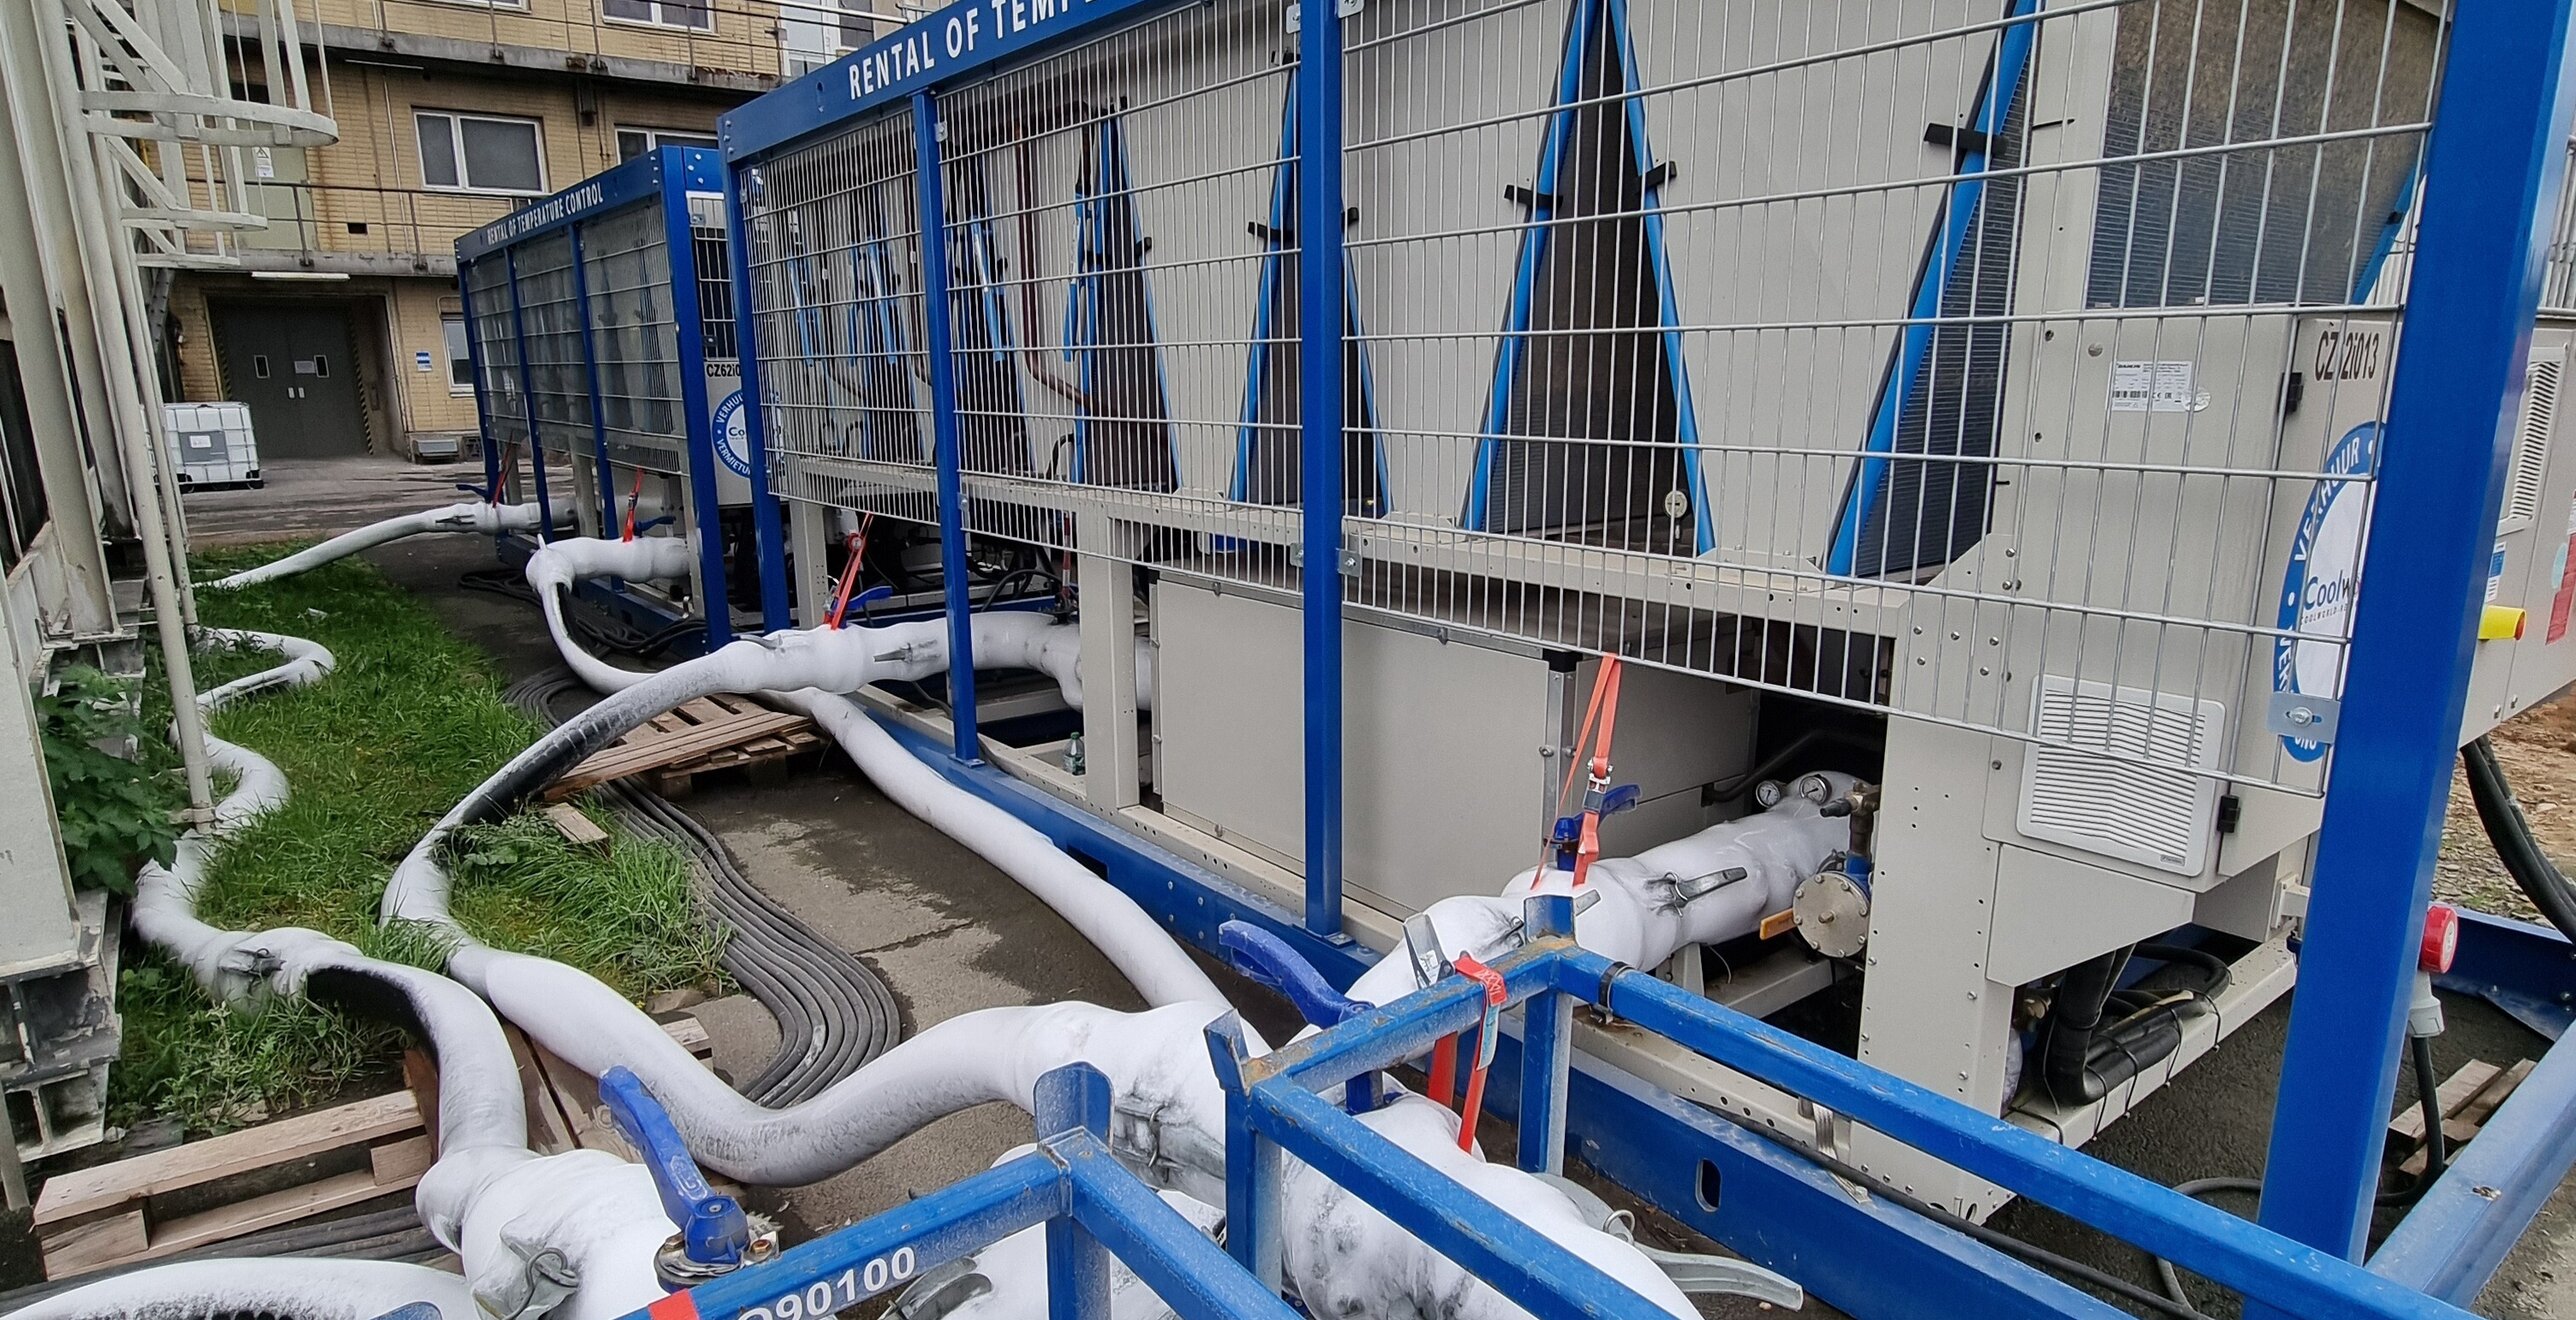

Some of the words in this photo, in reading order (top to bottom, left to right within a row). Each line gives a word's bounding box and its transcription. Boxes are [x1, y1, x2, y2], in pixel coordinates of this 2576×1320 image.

[849, 30, 935, 100] RENTAL
[945, 7, 980, 58] OF
[486, 222, 509, 246] RENTAL
[508, 218, 518, 239] OF
[517, 198, 565, 235] TEMPERATURE
[565, 181, 604, 215] CONTROL
[2315, 330, 2379, 381] CZ2i013
